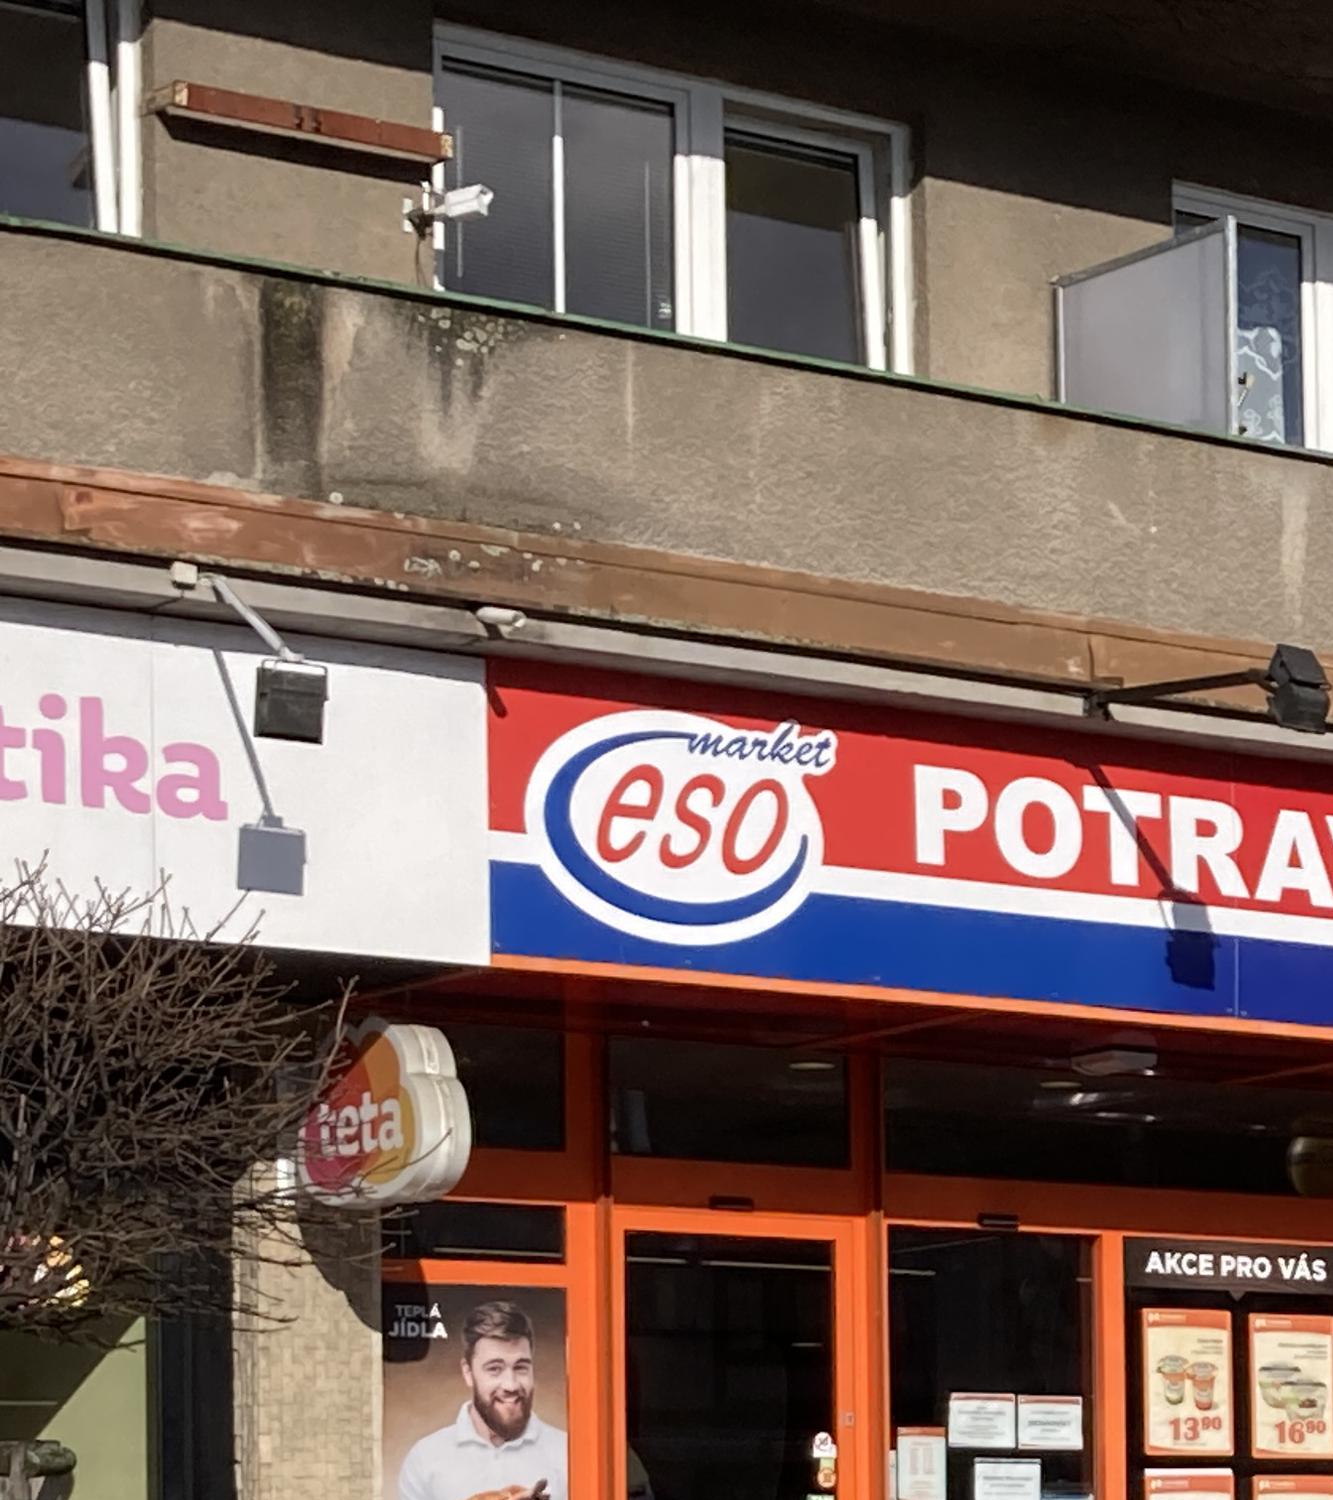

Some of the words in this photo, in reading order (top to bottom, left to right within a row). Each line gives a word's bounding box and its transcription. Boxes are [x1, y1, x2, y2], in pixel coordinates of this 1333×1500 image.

[687, 724, 832, 768] market
[596, 764, 789, 875] eso
[318, 1091, 404, 1157] teta
[1145, 1251, 1214, 1276] AKCE
[1220, 1255, 1272, 1279] PRO
[1277, 1253, 1327, 1281] VÁS
[388, 1317, 448, 1339] JÍDLA
[395, 1302, 441, 1318] TEPLÁ
